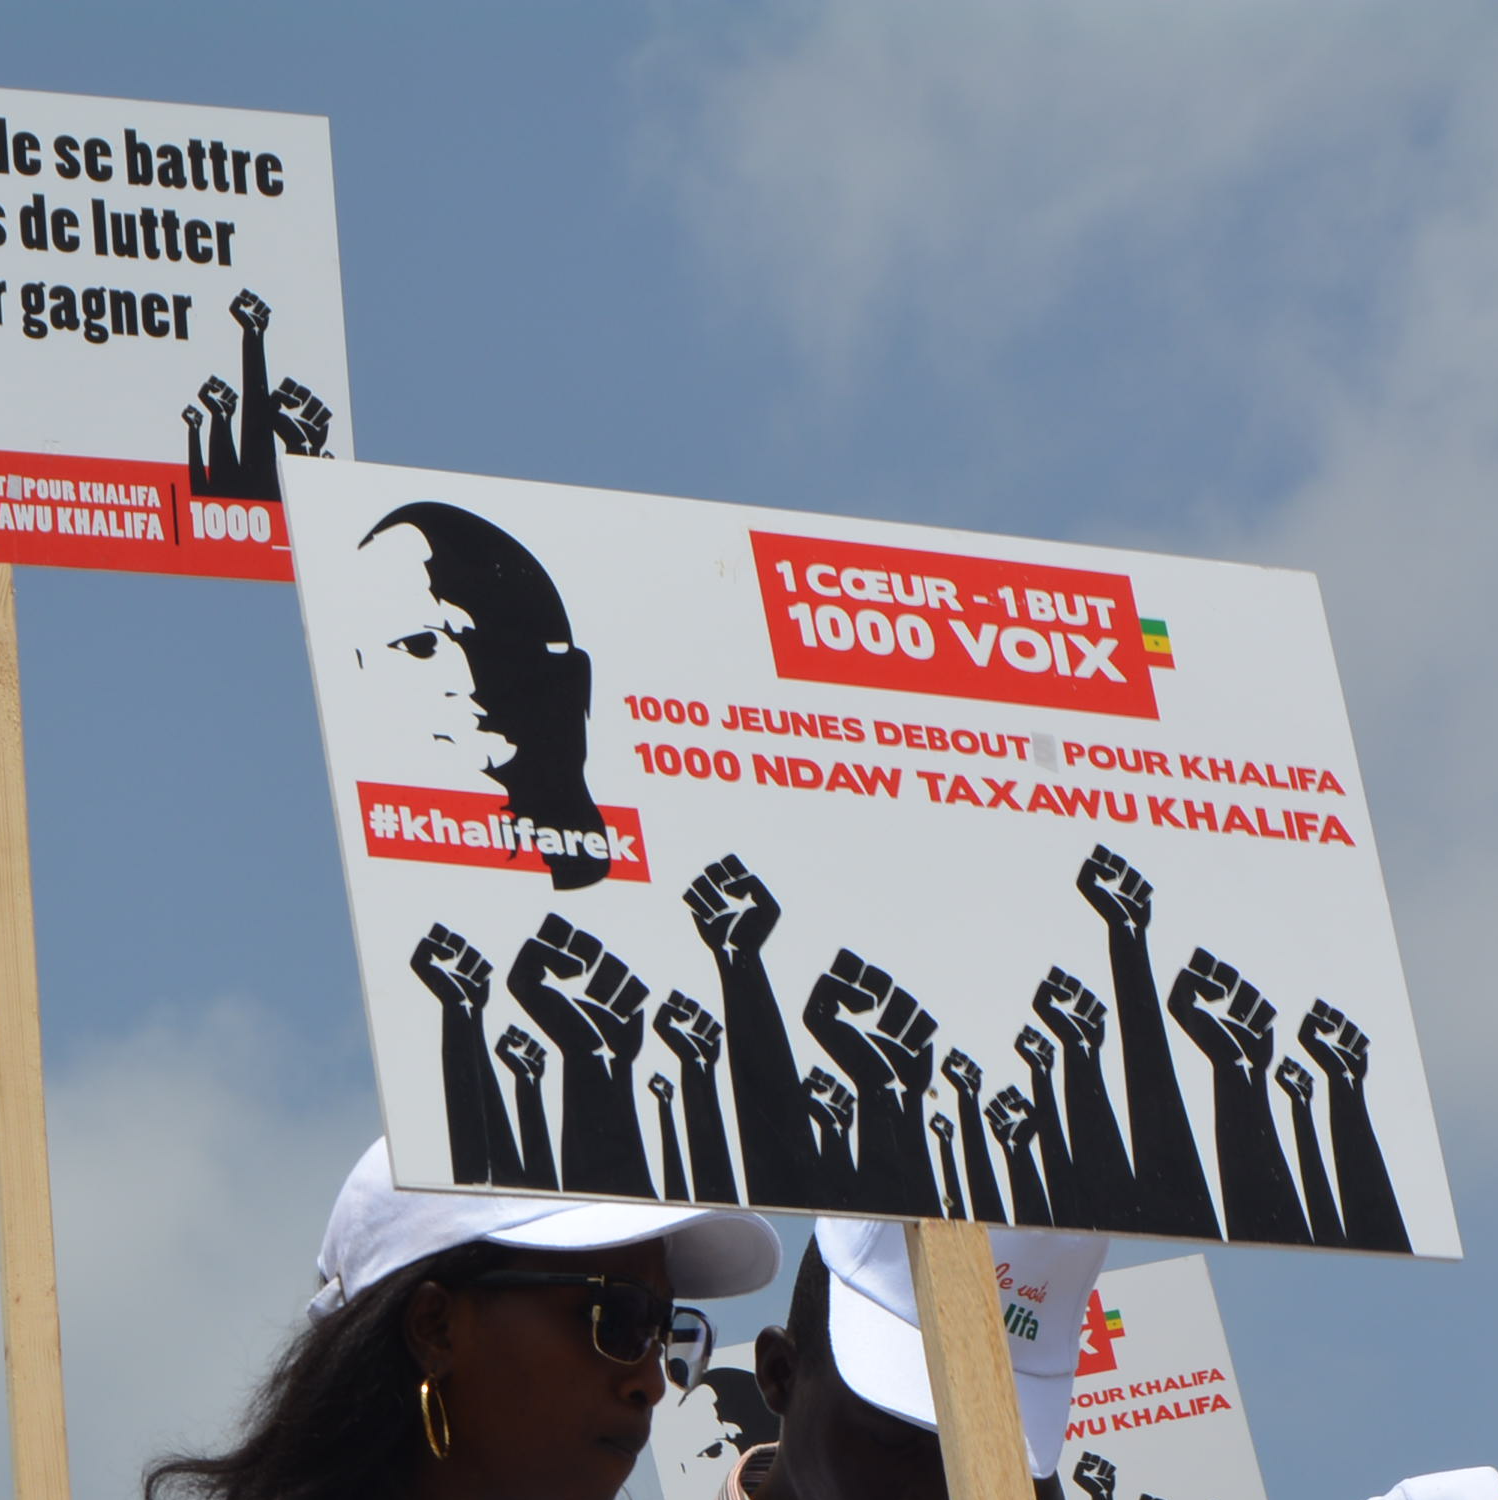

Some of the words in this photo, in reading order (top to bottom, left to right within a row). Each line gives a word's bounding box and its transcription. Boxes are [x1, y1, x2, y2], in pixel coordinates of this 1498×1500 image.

[54, 136, 112, 181] se
[125, 130, 283, 196] battre
[20, 195, 79, 252] de
[92, 200, 234, 265] lutter
[21, 283, 191, 343] gagner
[23, 476, 75, 503] POUR
[80, 483, 161, 507] KHALIFA
[58, 508, 164, 540] KHALIFA
[190, 502, 293, 550] 1000_
[777, 562, 796, 592] 1
[807, 565, 962, 611] CŒUR
[998, 587, 1017, 617] 1
[1026, 590, 1115, 628] BUT
[789, 604, 934, 659] 1000
[950, 620, 1126, 682] VOIX
[625, 696, 709, 726] 1000
[723, 706, 865, 742] JEUNES
[1064, 742, 1171, 776] POUR
[1180, 755, 1345, 794] KHALIFA
[635, 744, 741, 782] 1000
[753, 754, 901, 798] NDAW
[917, 772, 1138, 822] TAXAWU
[1148, 797, 1354, 846] KHALIFA
[369, 802, 639, 864] #khalifarek
[1004, 1303, 1039, 1341] lifa
[1113, 1395, 1230, 1430] KHALIFA
[1130, 1370, 1224, 1397] KHALIFA
